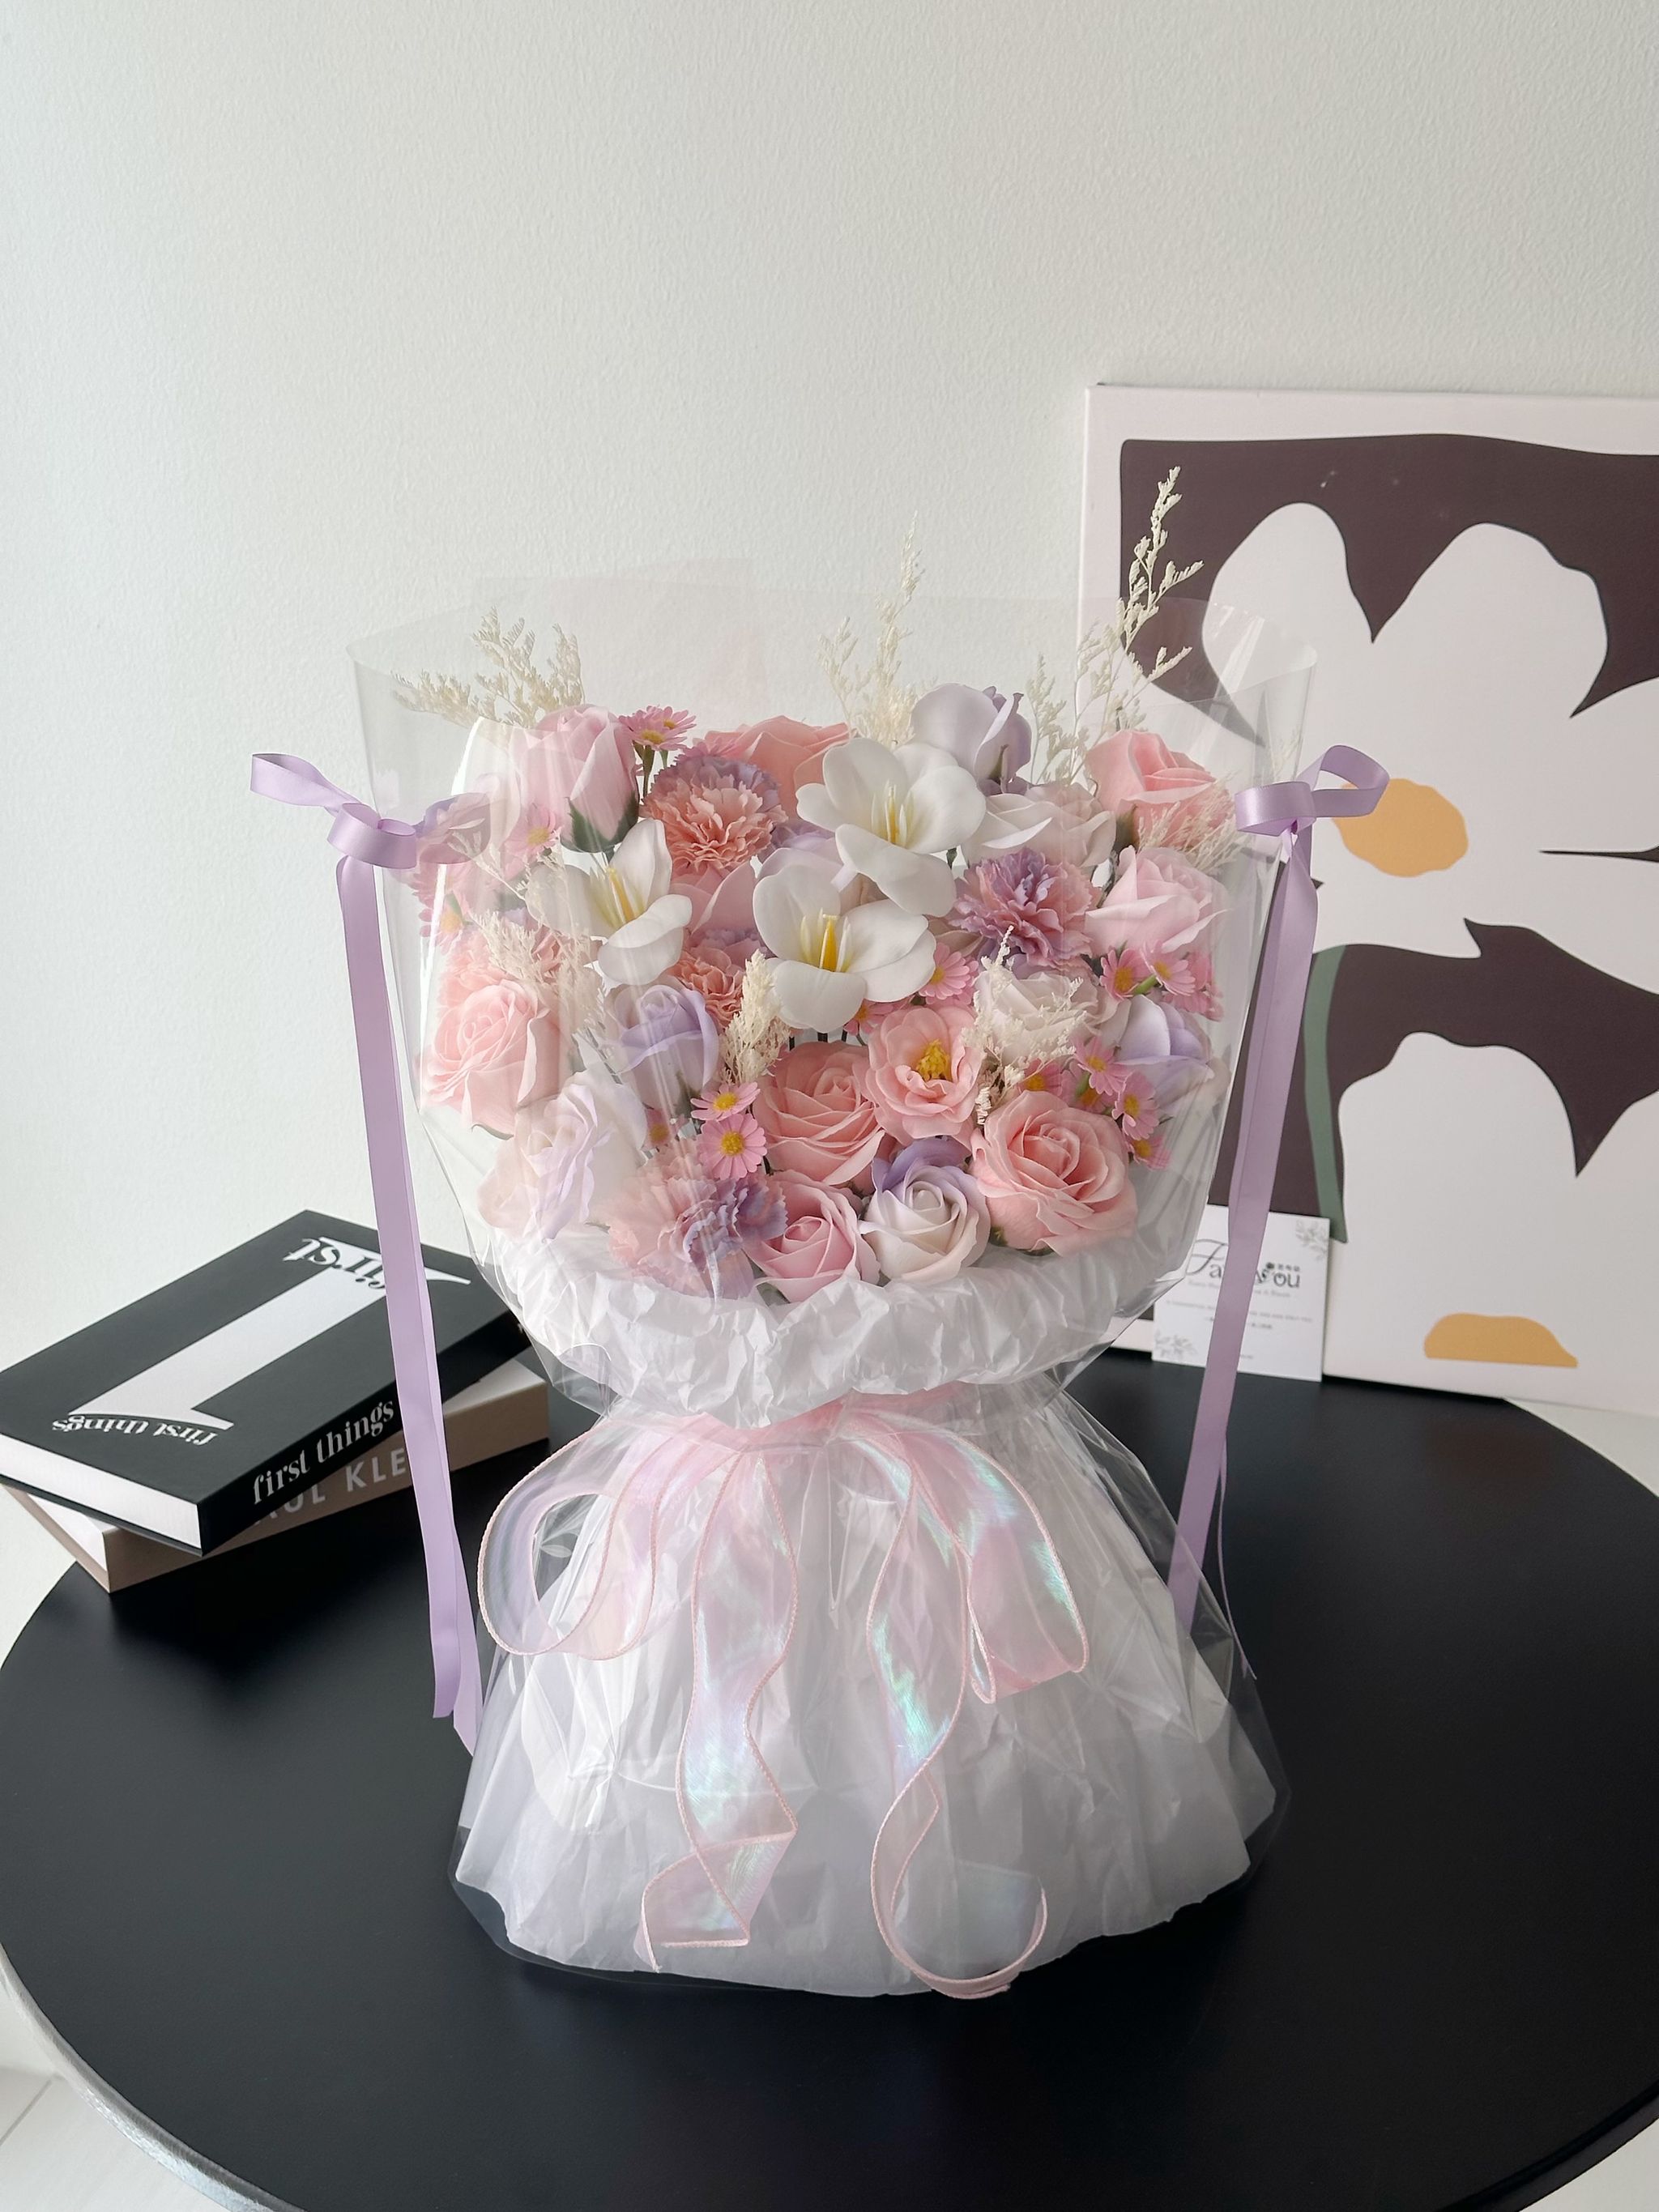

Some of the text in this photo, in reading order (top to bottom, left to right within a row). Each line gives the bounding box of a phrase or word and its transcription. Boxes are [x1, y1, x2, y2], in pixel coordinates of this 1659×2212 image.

[52, 1415, 218, 1445] first things
[253, 1400, 394, 1505] first things
[346, 1448, 406, 1493] KLE
